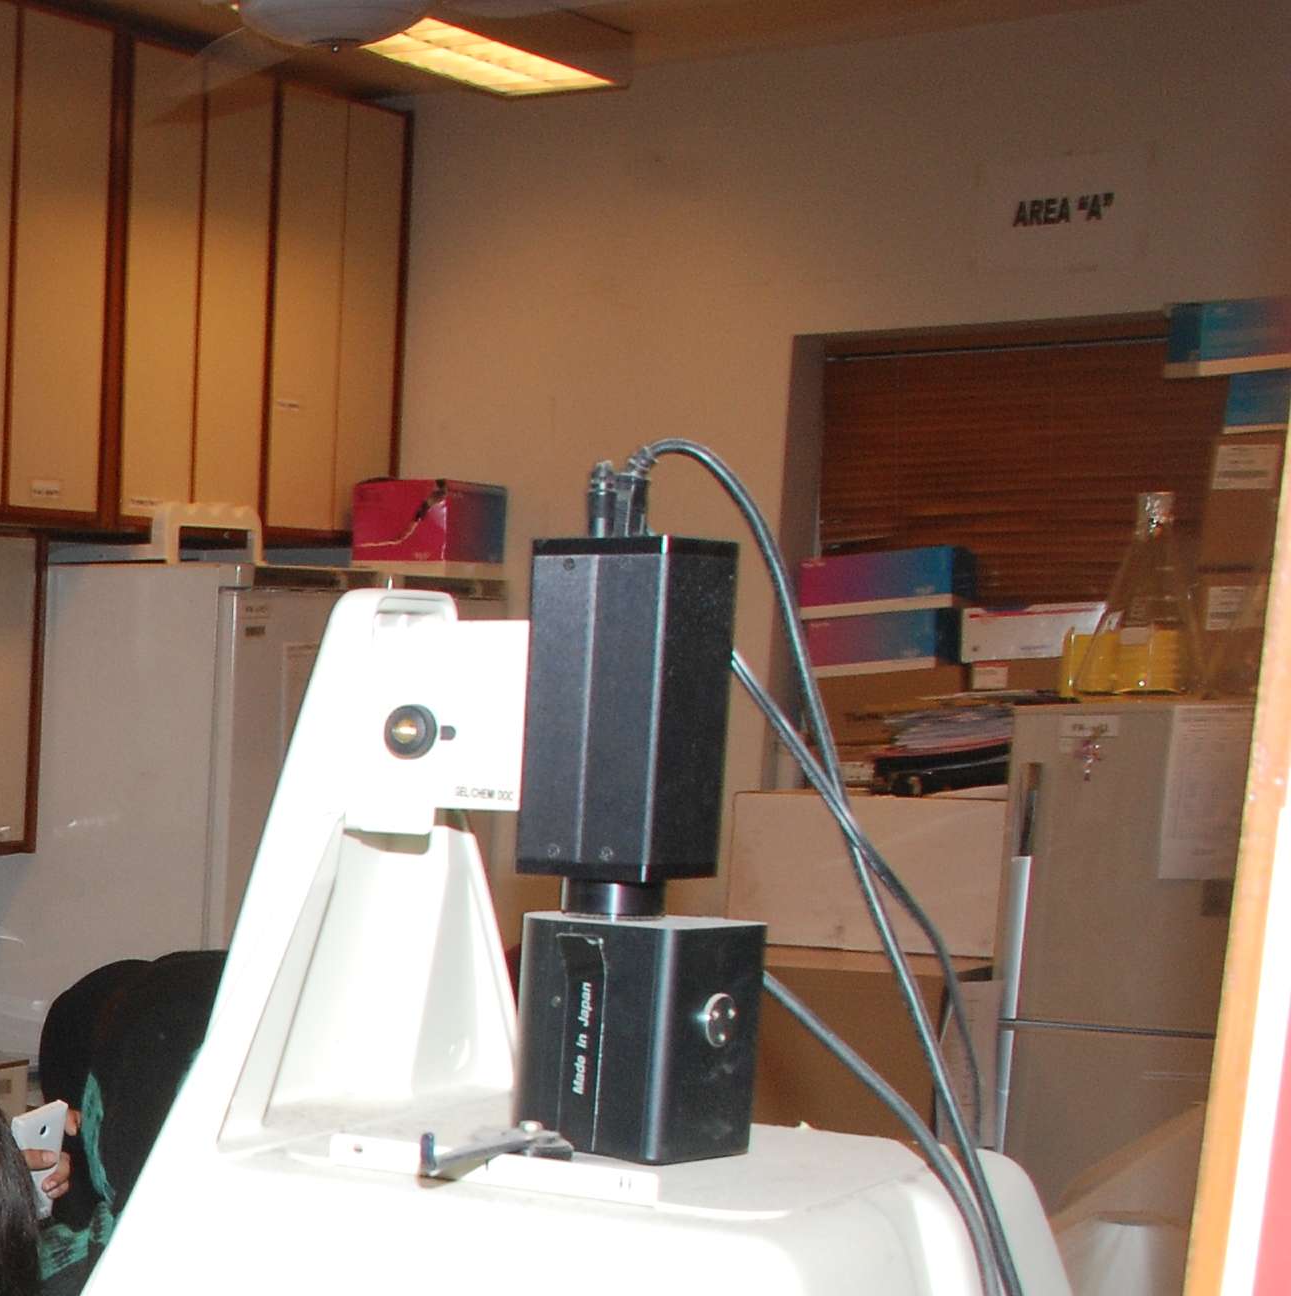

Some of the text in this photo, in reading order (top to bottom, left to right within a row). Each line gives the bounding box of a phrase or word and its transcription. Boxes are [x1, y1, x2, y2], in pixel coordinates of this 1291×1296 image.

[1012, 197, 1070, 227] AREA
[578, 981, 594, 1028] Japan
[572, 1054, 587, 1096] Made
